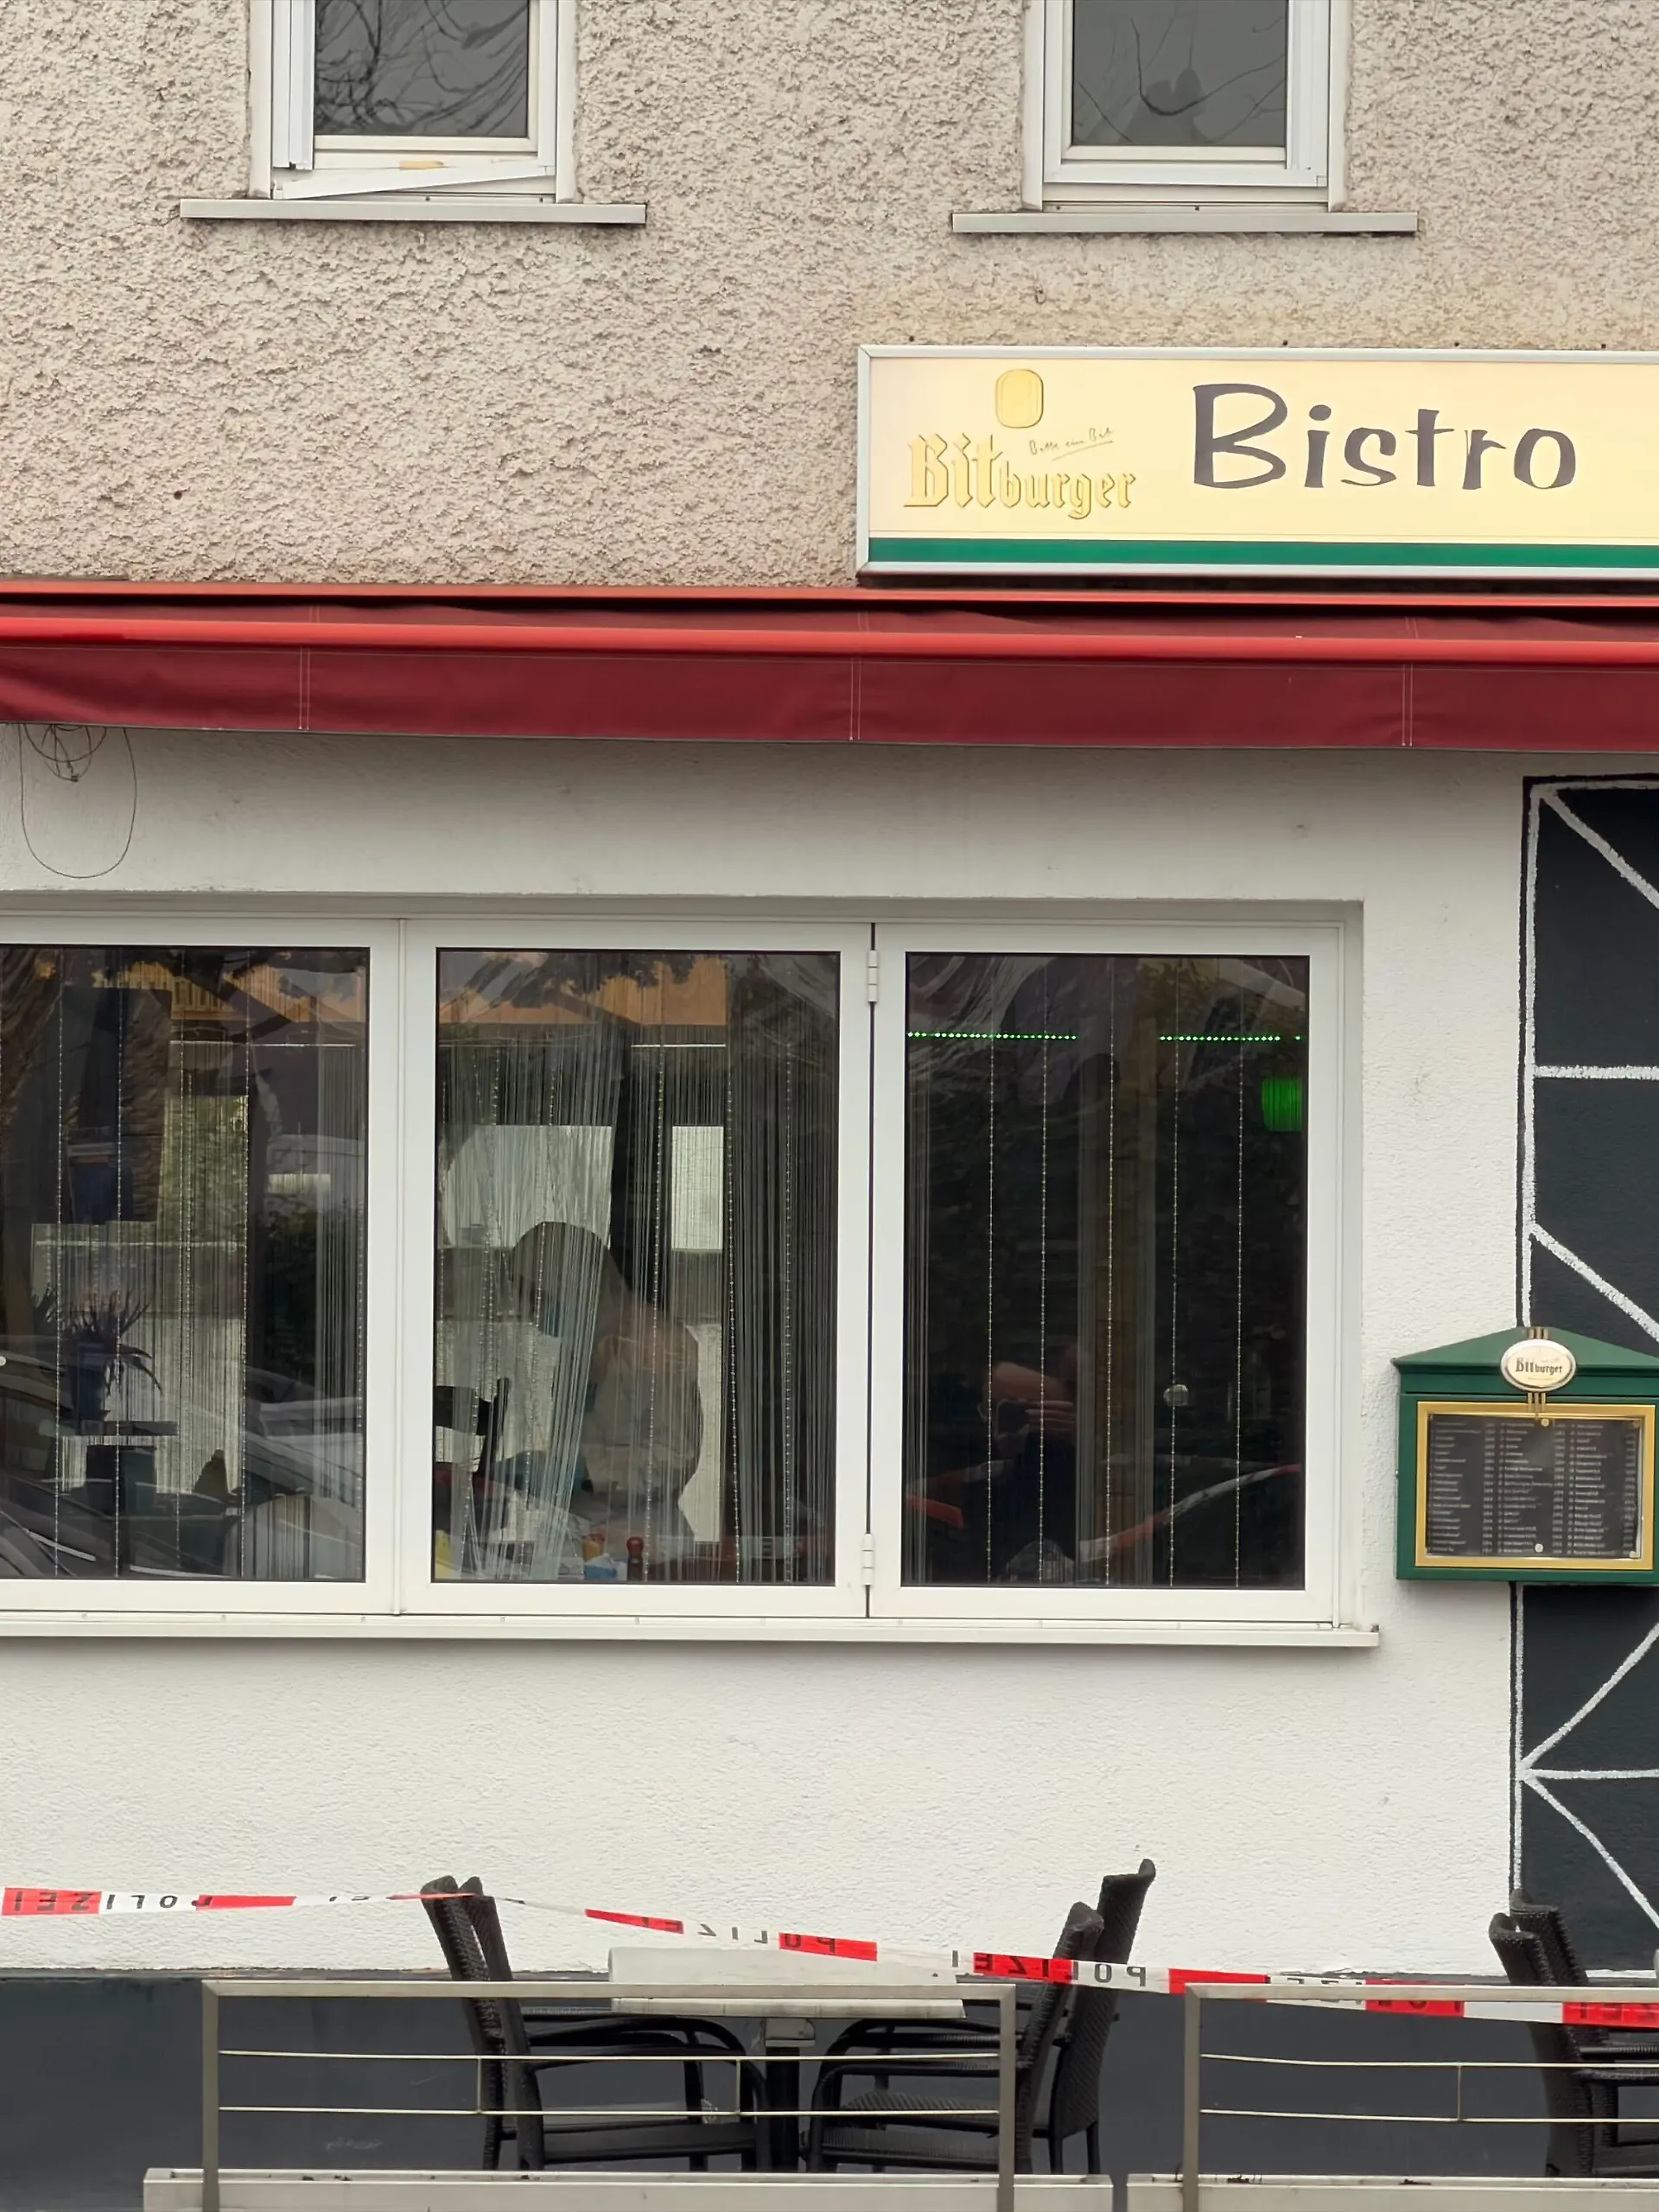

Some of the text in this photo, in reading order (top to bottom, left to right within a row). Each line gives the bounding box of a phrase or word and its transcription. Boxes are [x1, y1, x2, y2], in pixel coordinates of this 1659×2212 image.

[903, 432, 1136, 520] Bitburger
[1193, 383, 1576, 490] Bistro
[1515, 1357, 1563, 1376] Bitburger
